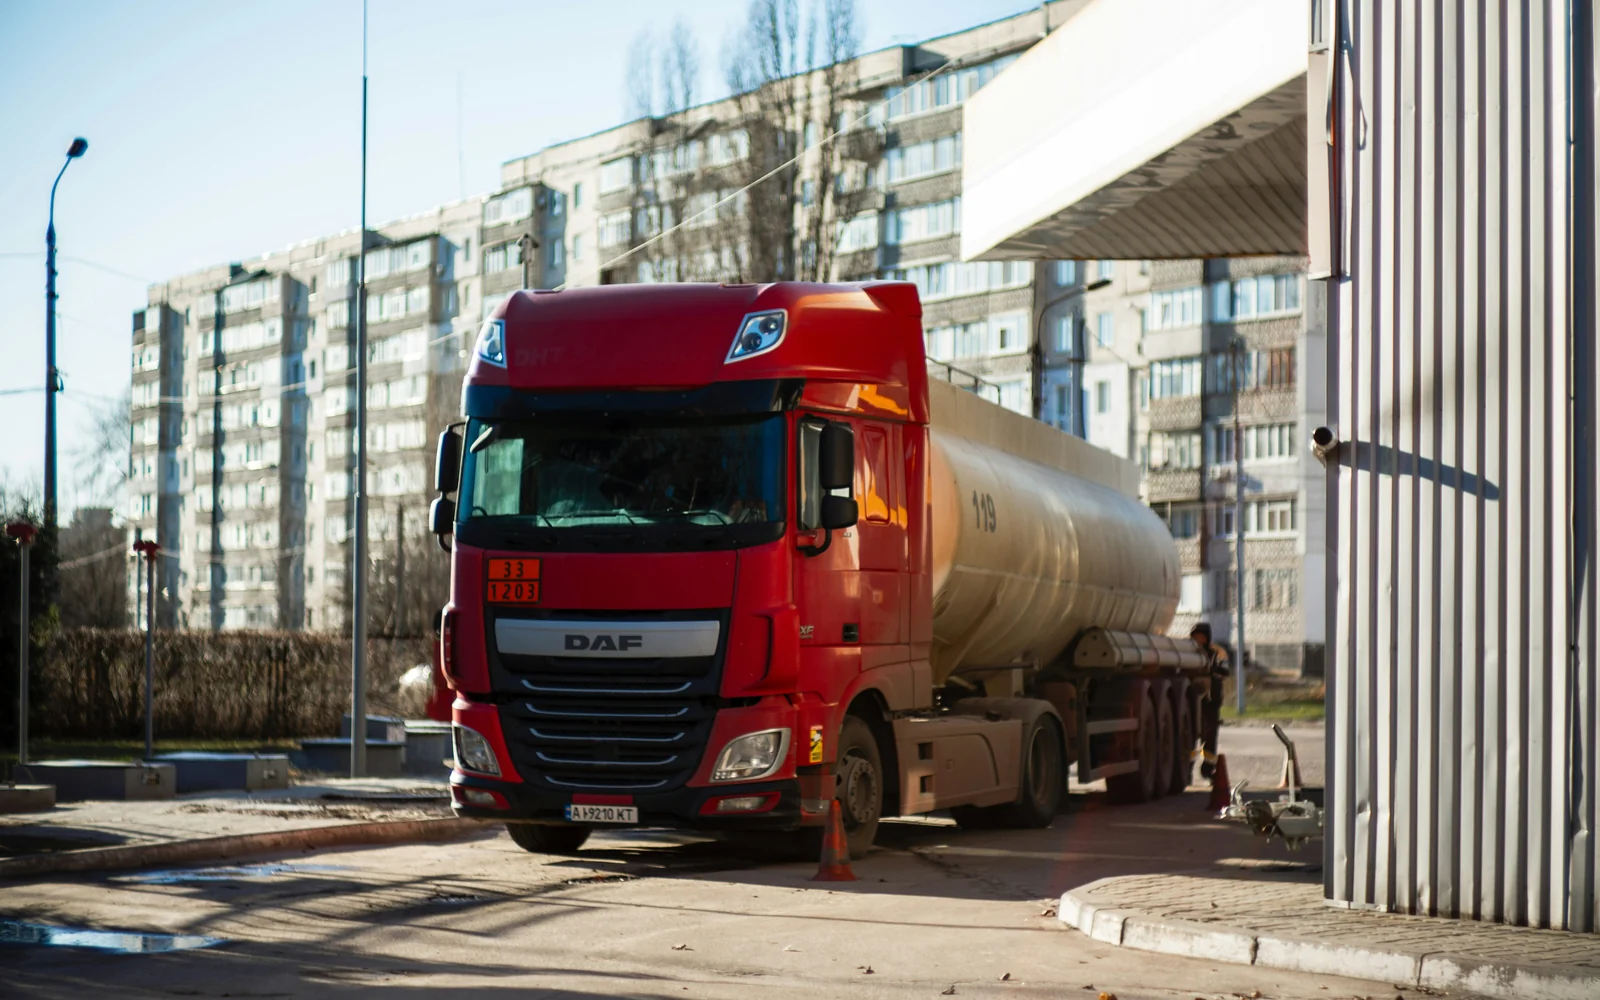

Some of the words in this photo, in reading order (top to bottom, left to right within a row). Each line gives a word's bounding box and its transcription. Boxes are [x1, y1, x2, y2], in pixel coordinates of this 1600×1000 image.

[972, 489, 997, 533] 119
[503, 561, 524, 578] 33
[490, 583, 535, 600] 1203
[565, 635, 642, 651] DAF
[589, 808, 614, 820] 9210
[617, 809, 633, 820] KT
